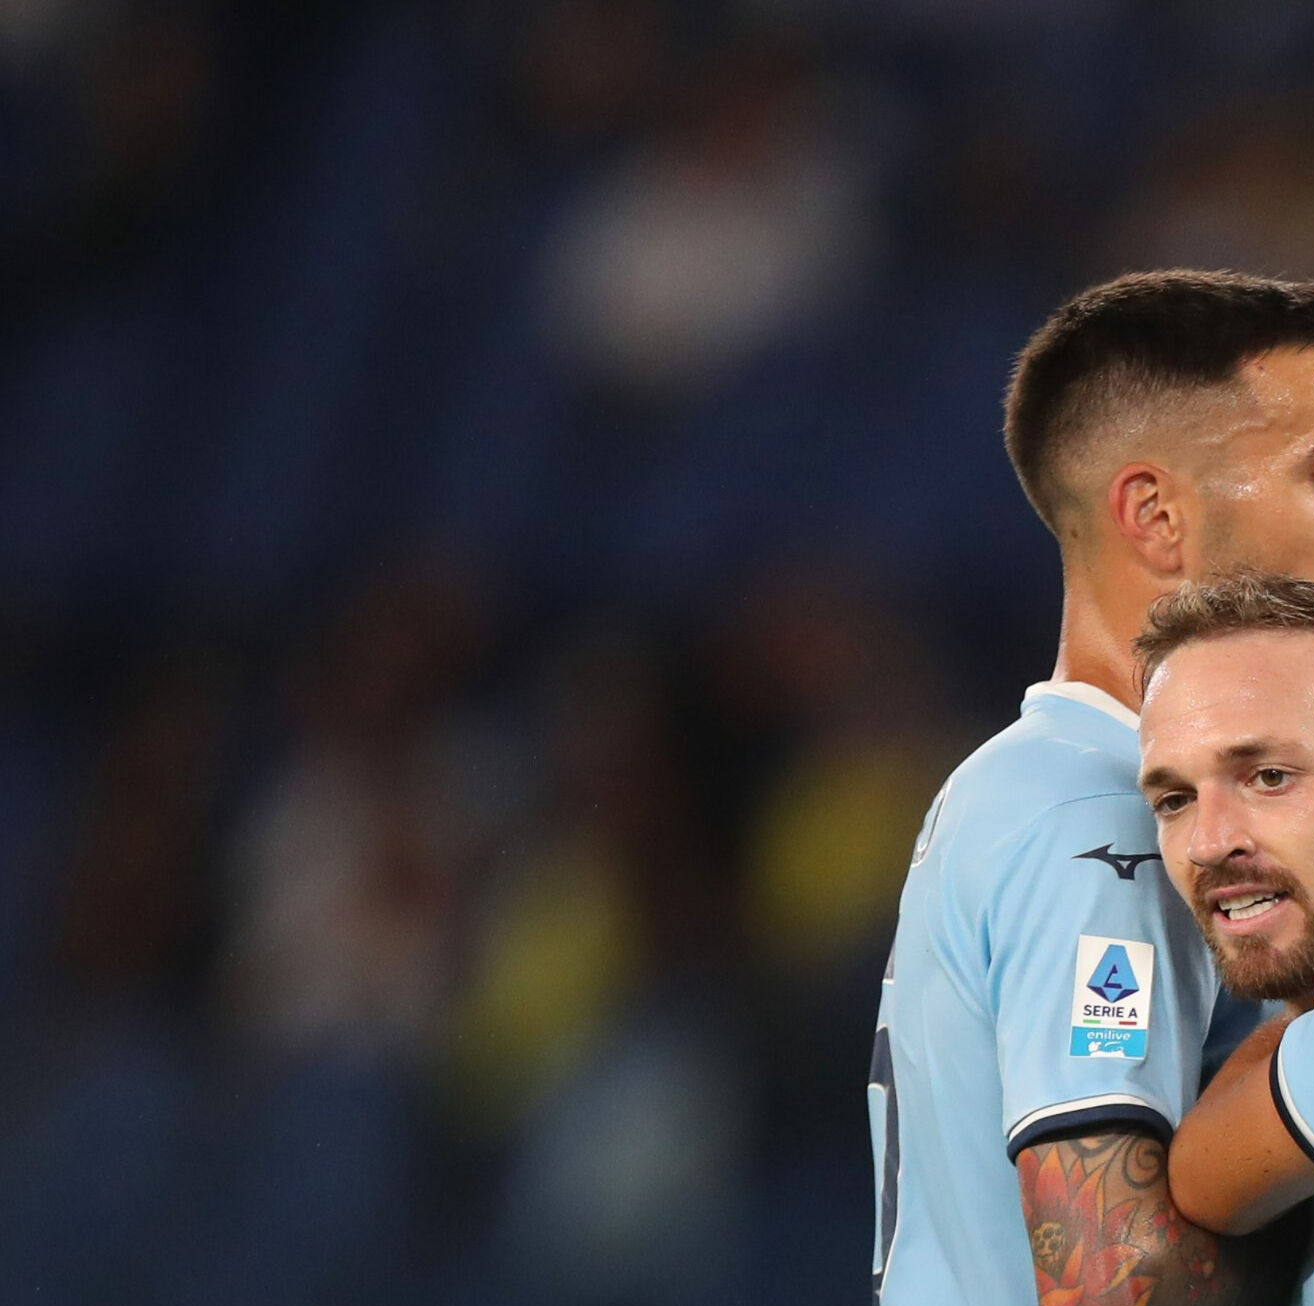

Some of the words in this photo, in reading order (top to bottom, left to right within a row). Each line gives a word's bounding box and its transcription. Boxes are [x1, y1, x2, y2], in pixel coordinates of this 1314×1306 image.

[1082, 1004, 1125, 1018] SERIE
[1128, 1007, 1138, 1018] A
[1086, 1029, 1131, 1041] enilive
